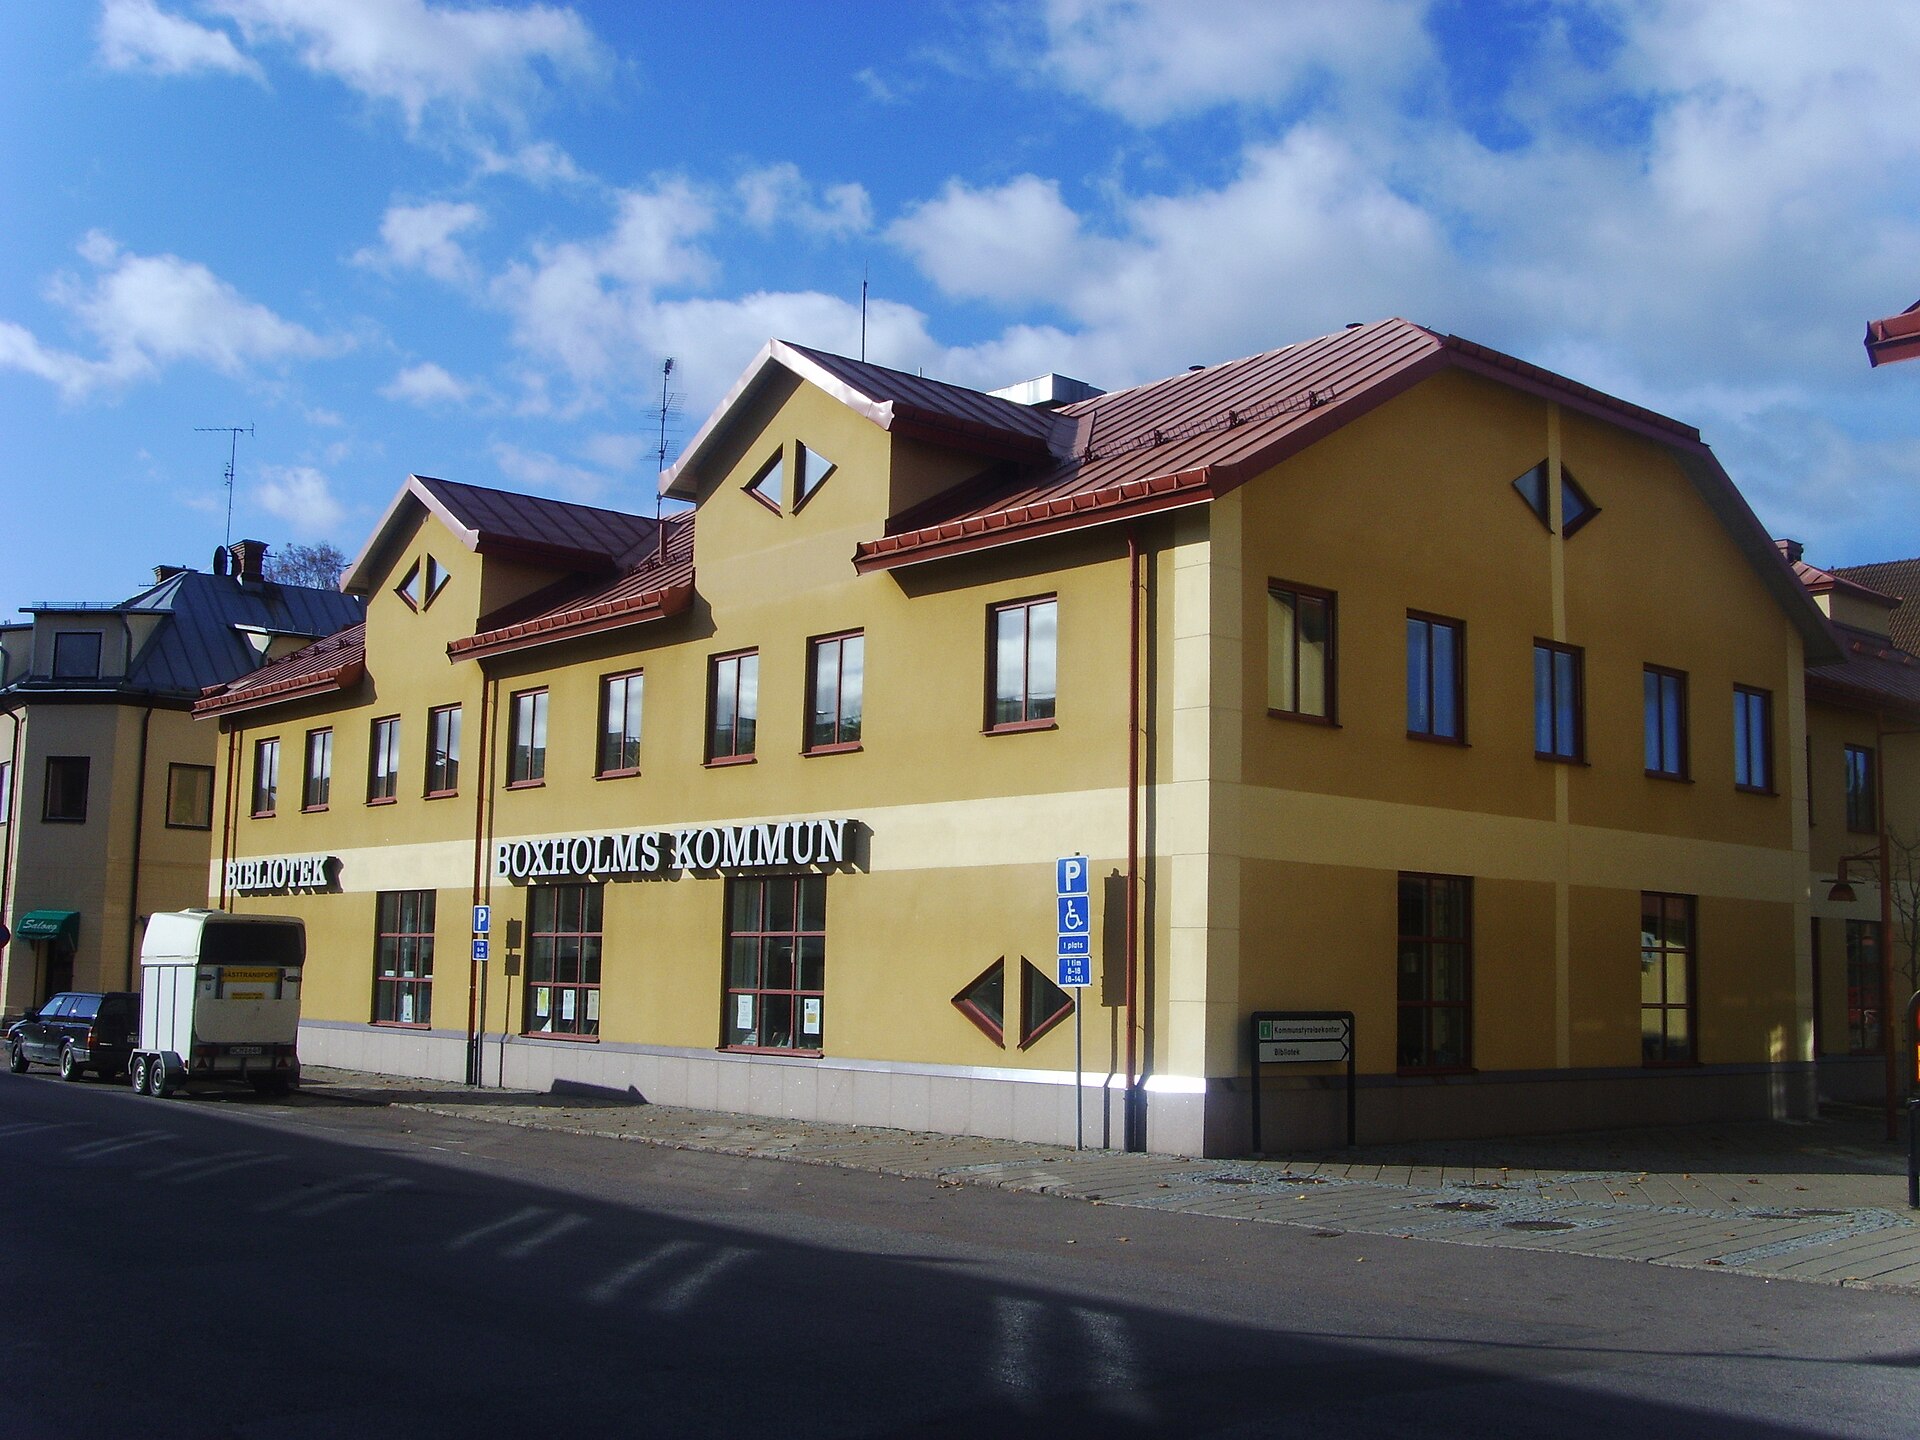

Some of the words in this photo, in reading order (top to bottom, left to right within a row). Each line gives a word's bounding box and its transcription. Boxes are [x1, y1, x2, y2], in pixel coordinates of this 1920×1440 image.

[495, 831, 660, 878] BOXHOLMS
[672, 818, 848, 870] KOMMUN
[226, 856, 327, 890] BIBLIOTEK
[1065, 860, 1081, 891] P
[22, 919, 58, 933] Salong
[477, 908, 487, 930] P
